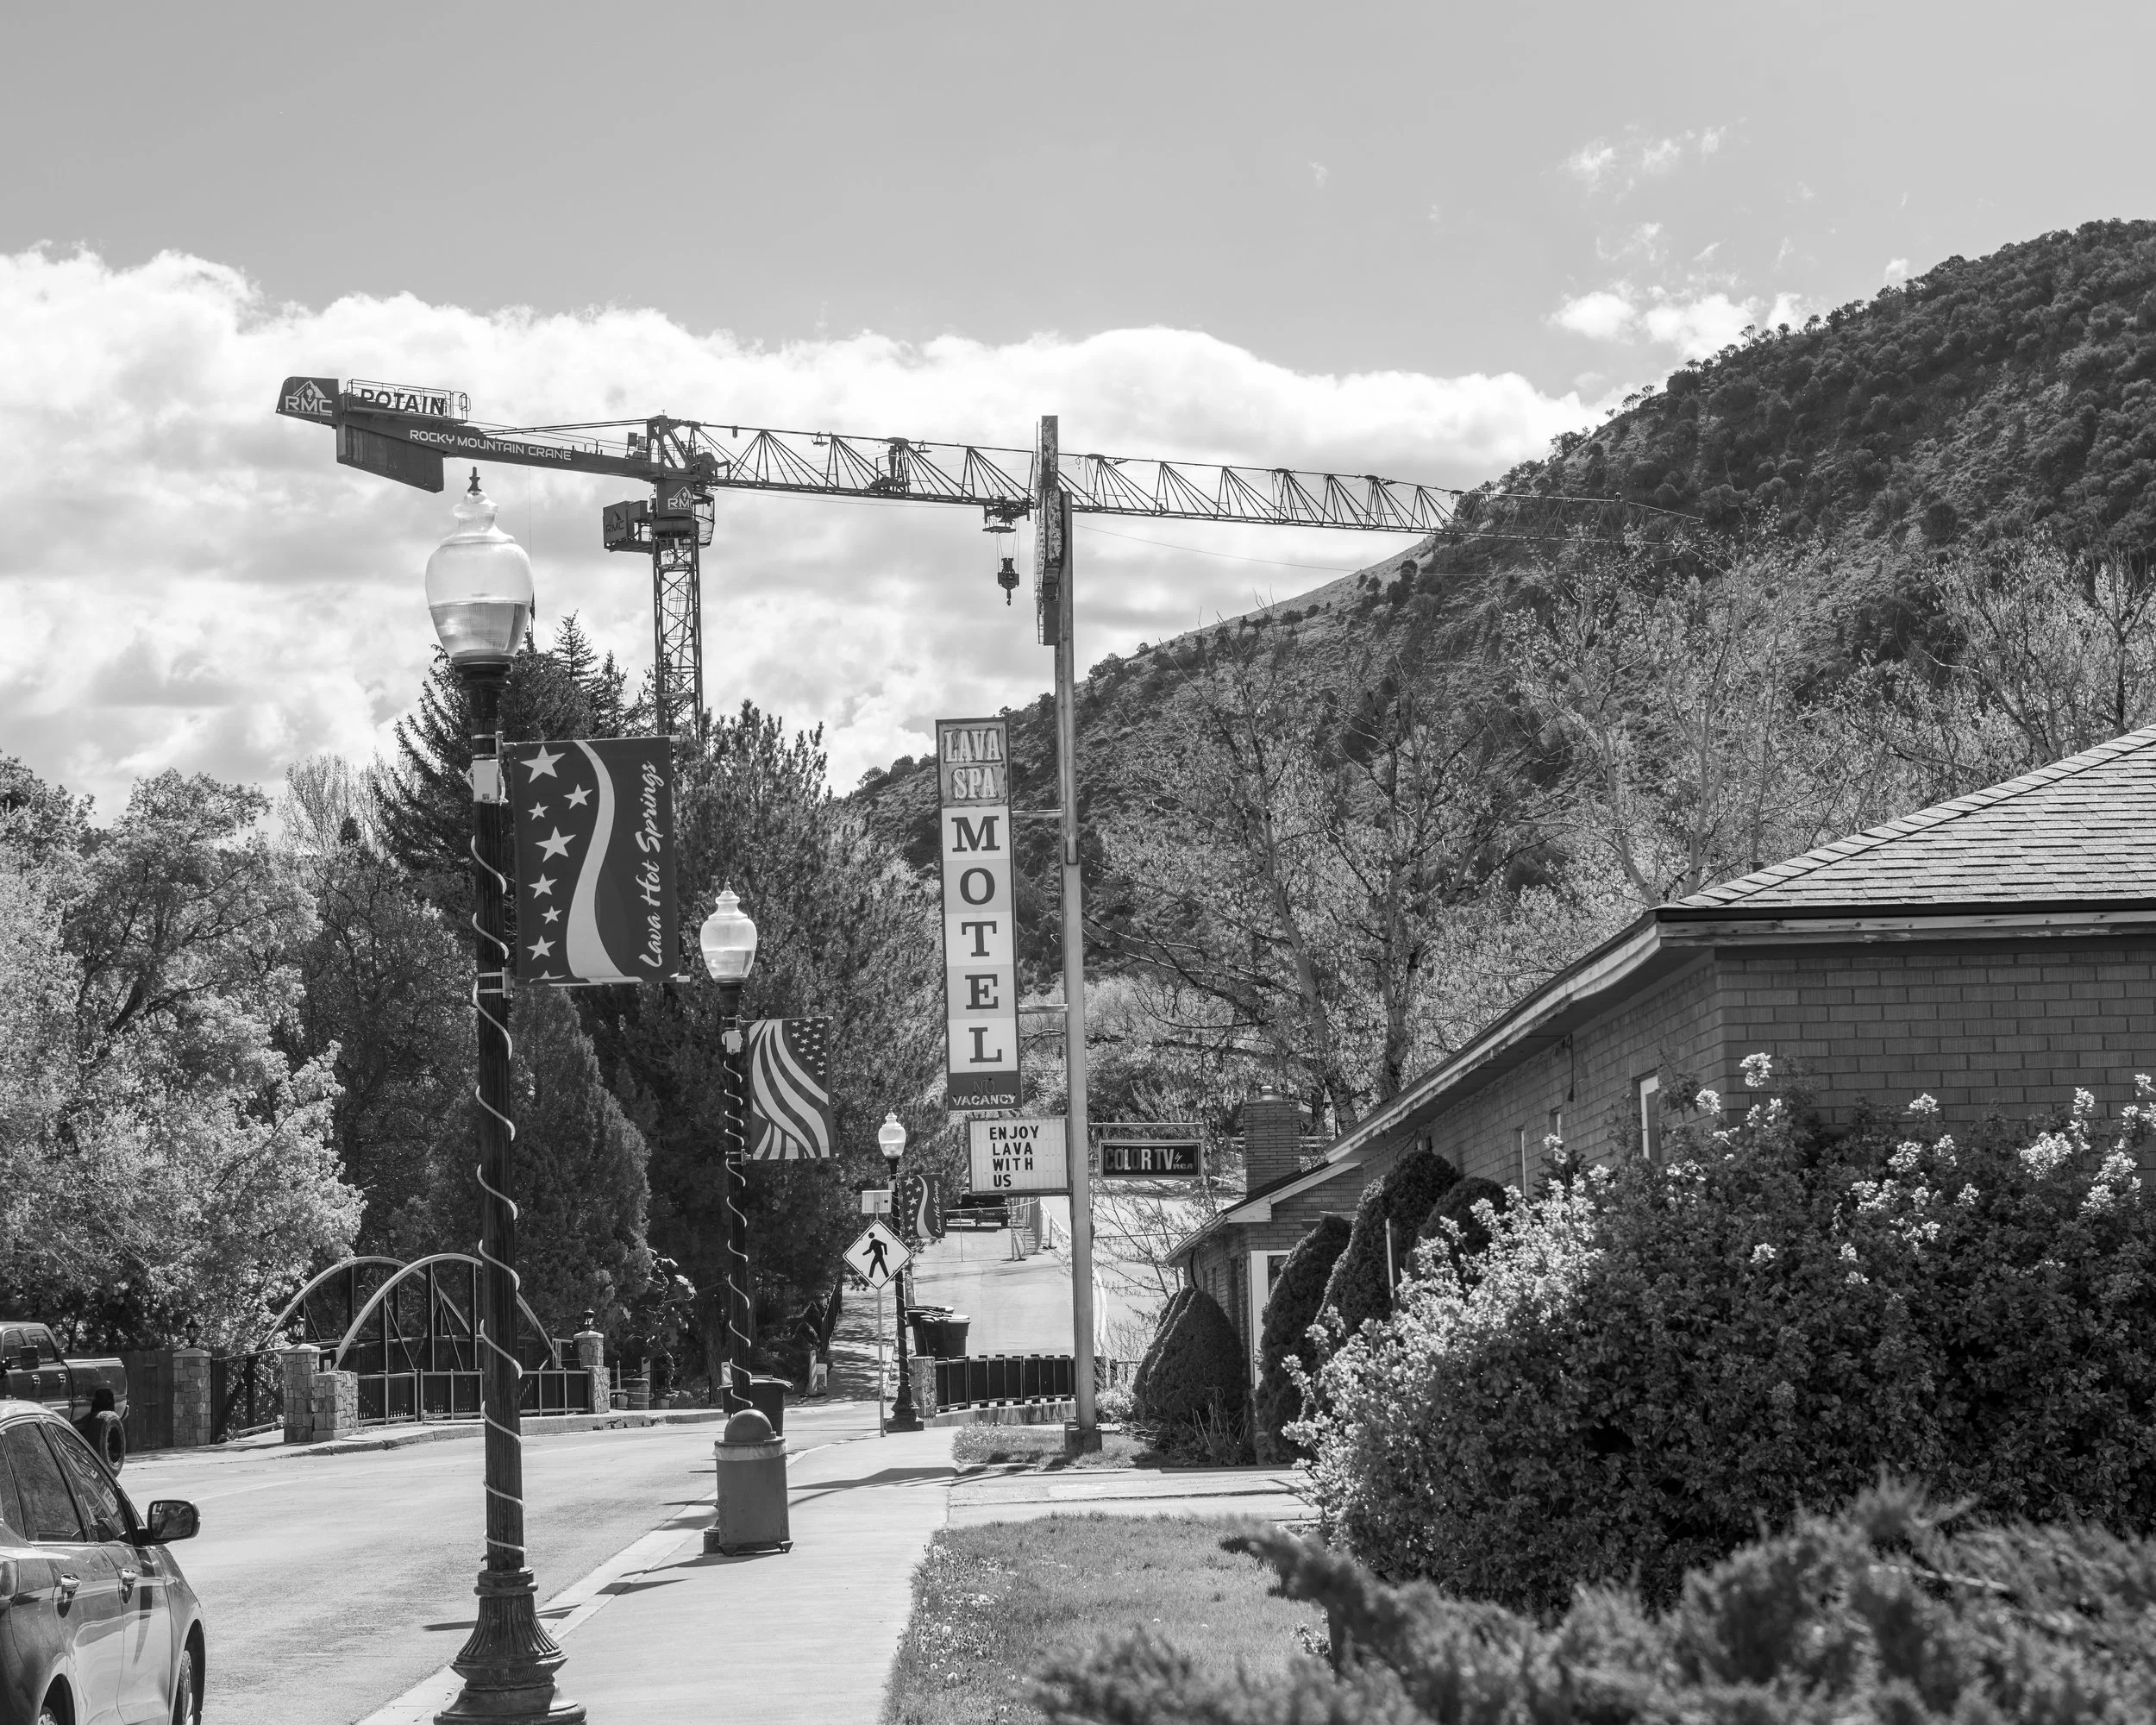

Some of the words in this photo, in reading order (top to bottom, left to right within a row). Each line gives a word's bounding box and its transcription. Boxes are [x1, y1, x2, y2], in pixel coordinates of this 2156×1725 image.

[285, 396, 333, 413] RMC
[361, 389, 445, 416] POTAIN
[410, 430, 455, 444] ROCKY
[457, 436, 524, 455] MOUNTAIN
[528, 445, 572, 461] CRANE
[605, 519, 625, 534] RMC
[944, 730, 1001, 762] LAVA
[953, 768, 997, 800] SPA
[635, 761, 664, 853] Springs
[636, 859, 661, 906] Hot
[639, 913, 662, 967] Lava
[951, 815, 1002, 1063] MOTEL
[974, 1078, 995, 1095] NO
[952, 1094, 1016, 1106] VACANCY
[989, 1126, 1039, 1140] ENJOY
[993, 1142, 1033, 1156] LAVA
[1105, 1148, 1152, 1170] COLOR
[1155, 1148, 1174, 1170] TV
[993, 1157, 1033, 1171] WITH
[993, 1174, 1012, 1188] US
